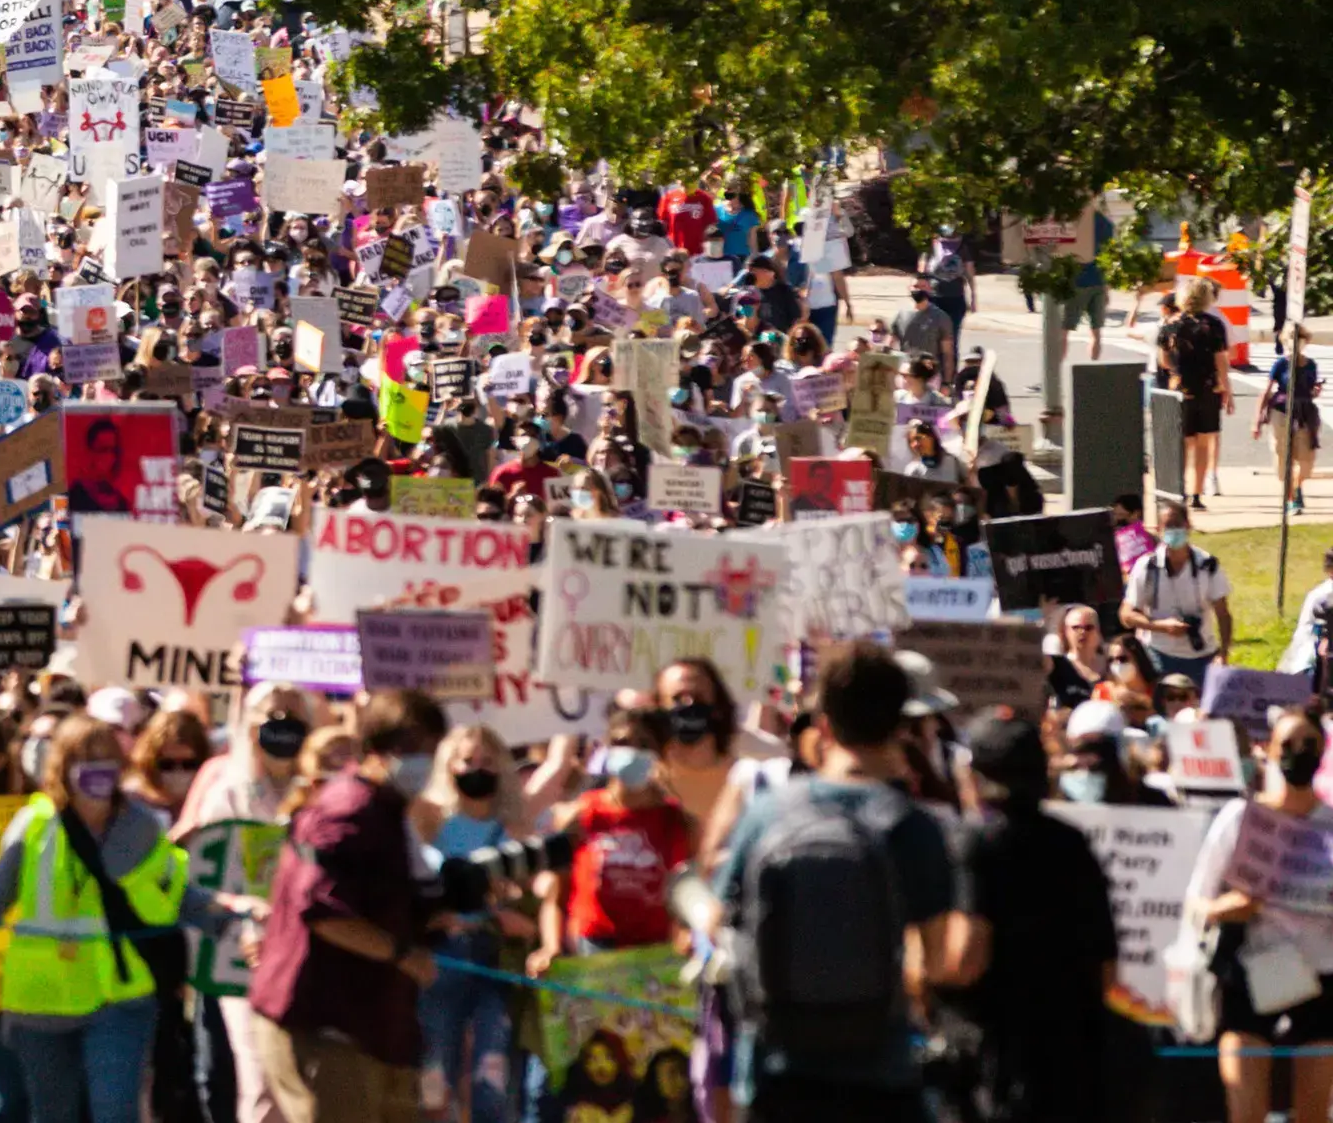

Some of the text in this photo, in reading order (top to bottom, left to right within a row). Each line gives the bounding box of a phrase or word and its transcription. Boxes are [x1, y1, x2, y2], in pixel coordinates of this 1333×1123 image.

[25, 23, 53, 38] BACK
[72, 80, 104, 97] MIND
[87, 92, 119, 105] OWN
[141, 457, 175, 482] WE
[316, 514, 530, 568] ABORTION
[624, 581, 714, 621] NOT
